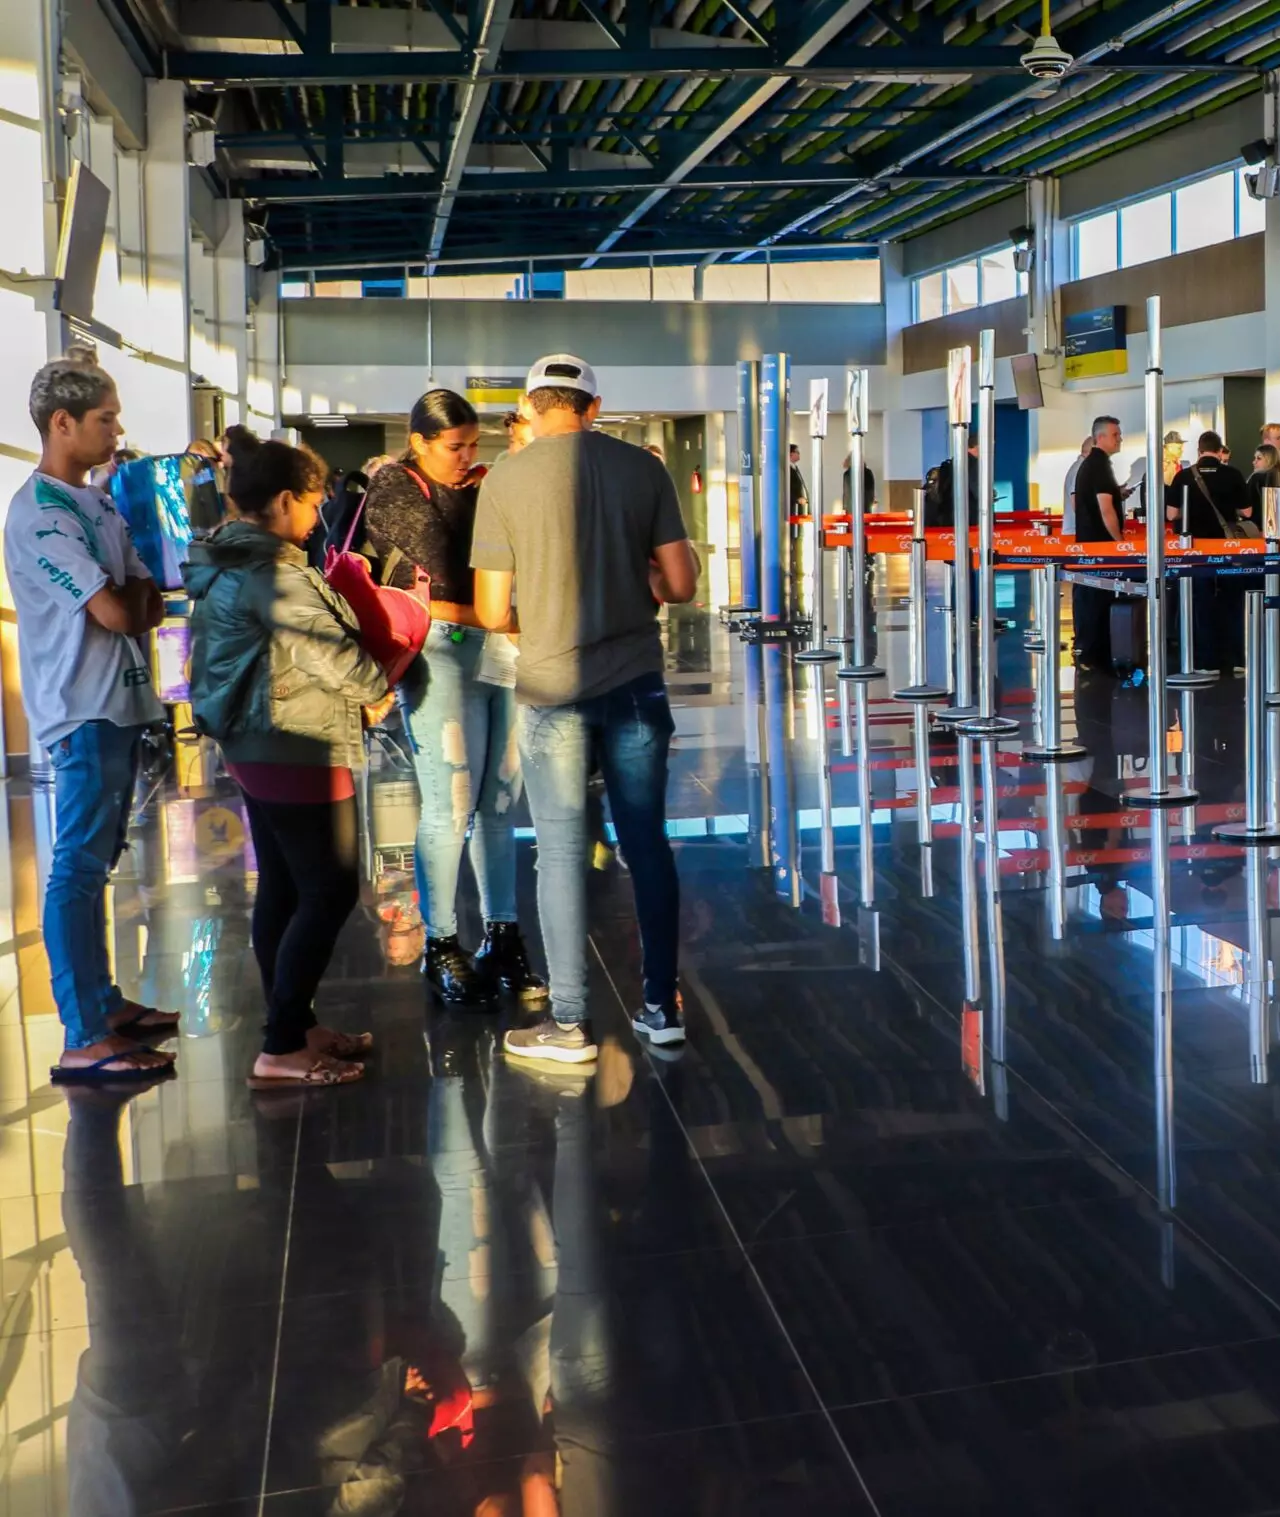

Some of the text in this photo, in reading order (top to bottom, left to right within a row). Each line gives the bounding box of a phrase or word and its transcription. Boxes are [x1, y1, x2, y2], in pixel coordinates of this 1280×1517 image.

[1065, 544, 1085, 553] GOL
[1116, 542, 1136, 551] GOL
[1077, 557, 1096, 565] Azul
[1216, 567, 1264, 575] voeazul.com.br
[37, 556, 83, 600] crefisa
